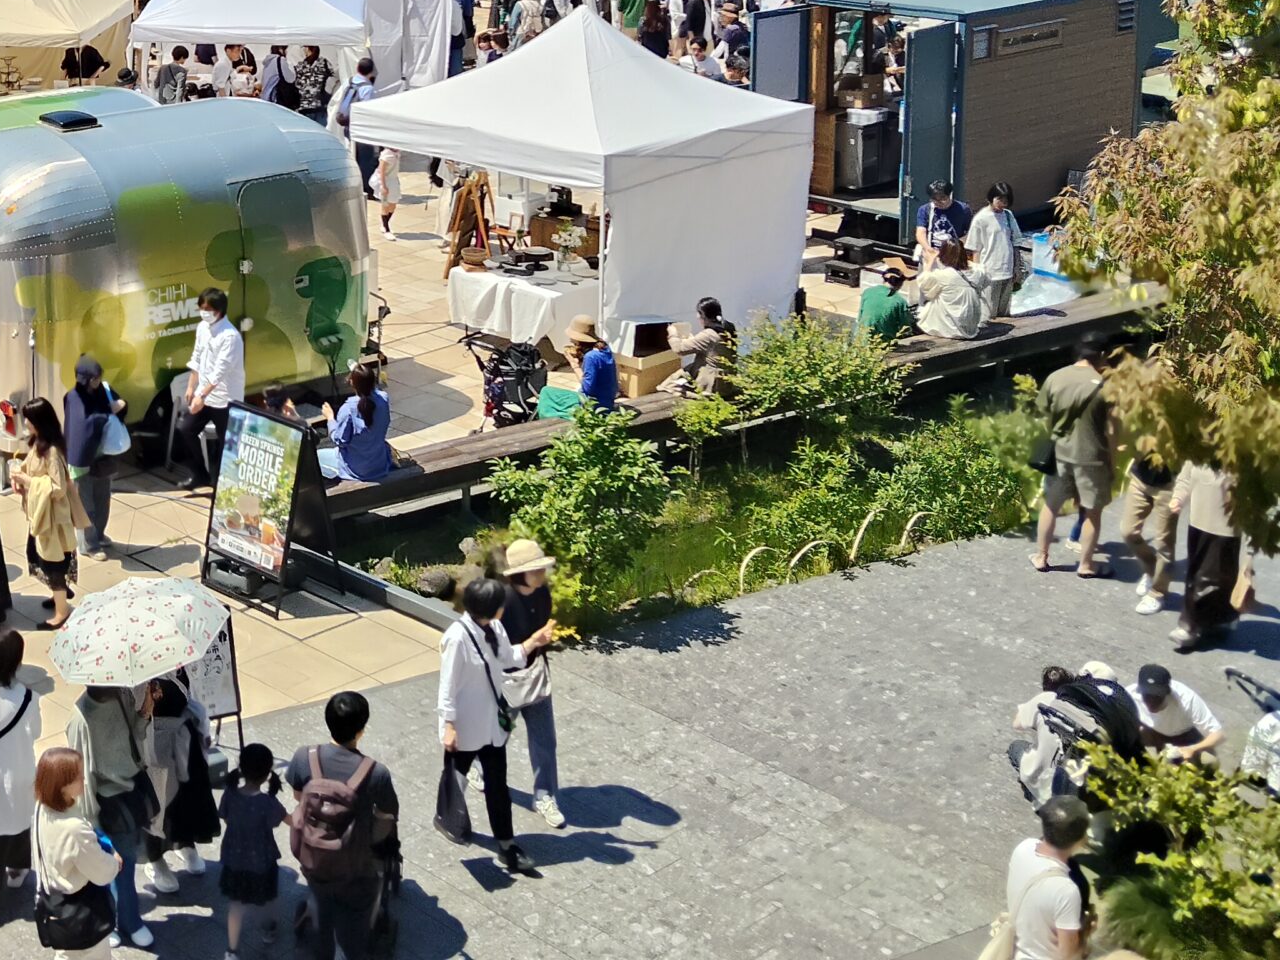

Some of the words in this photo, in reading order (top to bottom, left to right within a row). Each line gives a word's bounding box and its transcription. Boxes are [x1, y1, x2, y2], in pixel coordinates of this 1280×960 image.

[140, 283, 187, 305] CHIHI
[241, 433, 260, 448] GREEN
[260, 440, 285, 457] SPRINGS
[238, 443, 284, 476] MOBILE
[238, 462, 277, 493] ORDER
